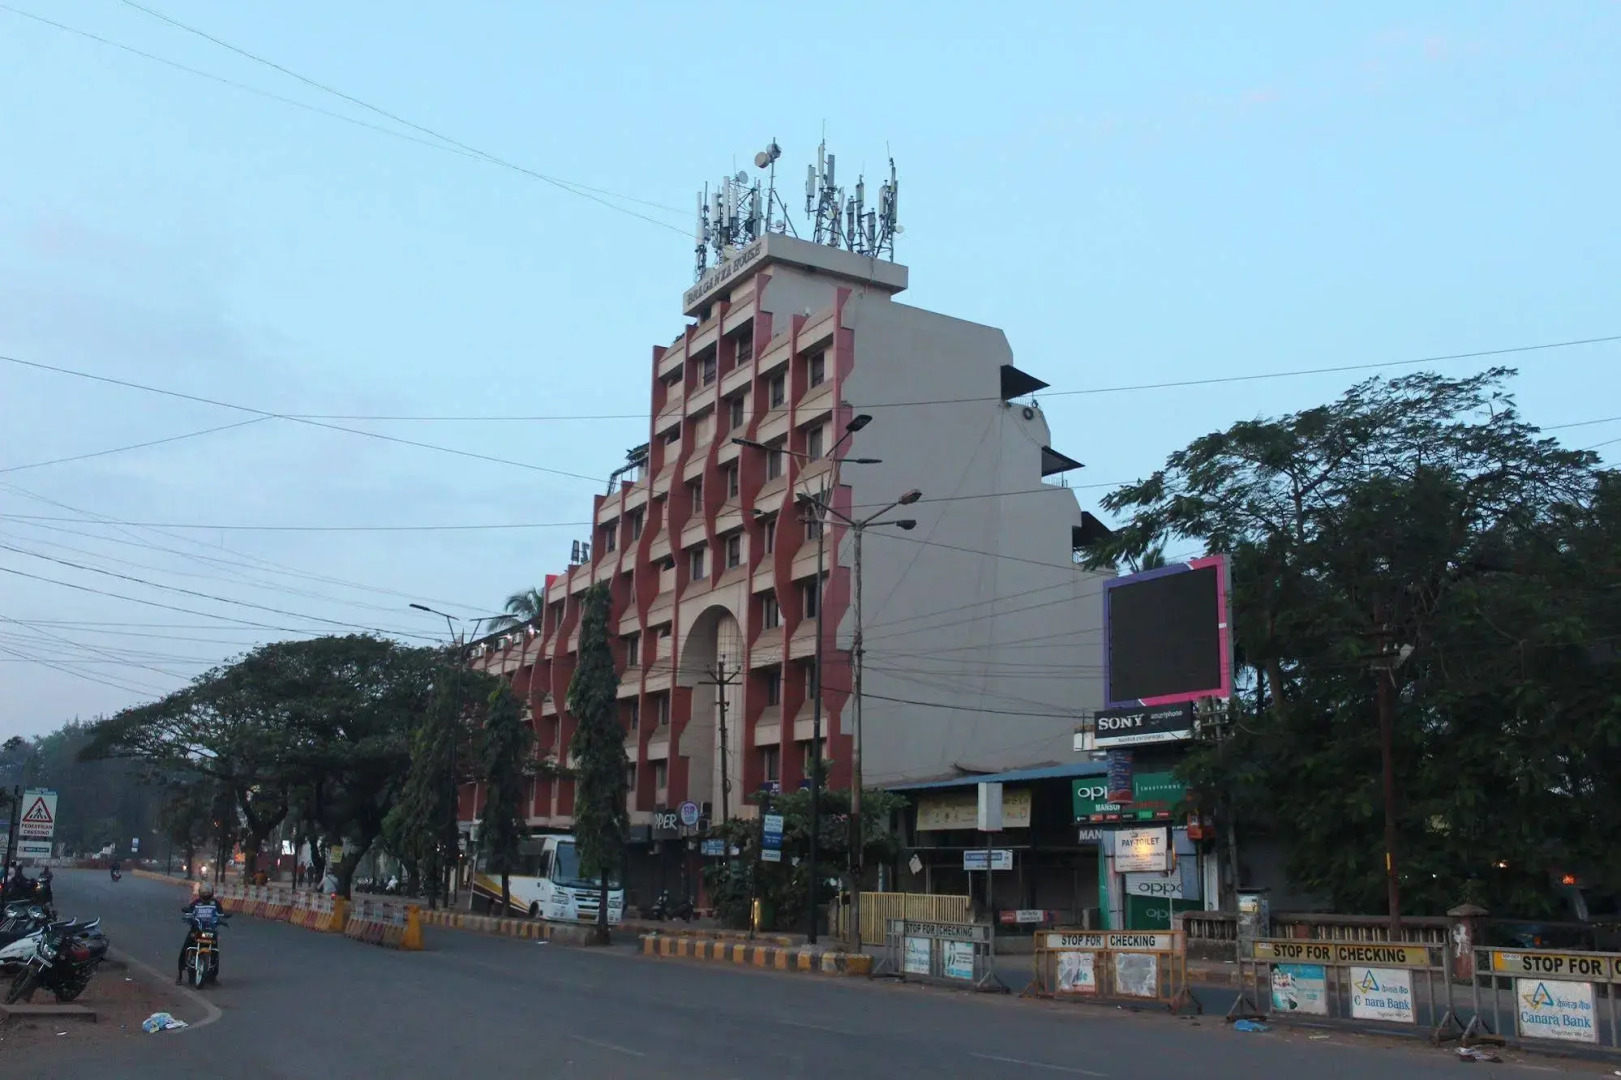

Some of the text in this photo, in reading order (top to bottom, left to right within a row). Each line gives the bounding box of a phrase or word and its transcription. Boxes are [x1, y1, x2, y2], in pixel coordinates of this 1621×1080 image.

[687, 243, 762, 305] BRAGANZA HOUSE
[1098, 713, 1145, 730] SONY
[905, 923, 973, 937] STOP FOR CHECKING
[1061, 935, 1156, 947] STOP FOR CHECKING
[1273, 943, 1303, 958] STOP
[1307, 946, 1331, 960] FOR
[1338, 947, 1407, 963] CHECKING
[1522, 956, 1563, 973] STOP
[1569, 958, 1603, 976] FOR
[1387, 998, 1411, 1010] Bank
[1521, 1011, 1592, 1028] Canara Bank
